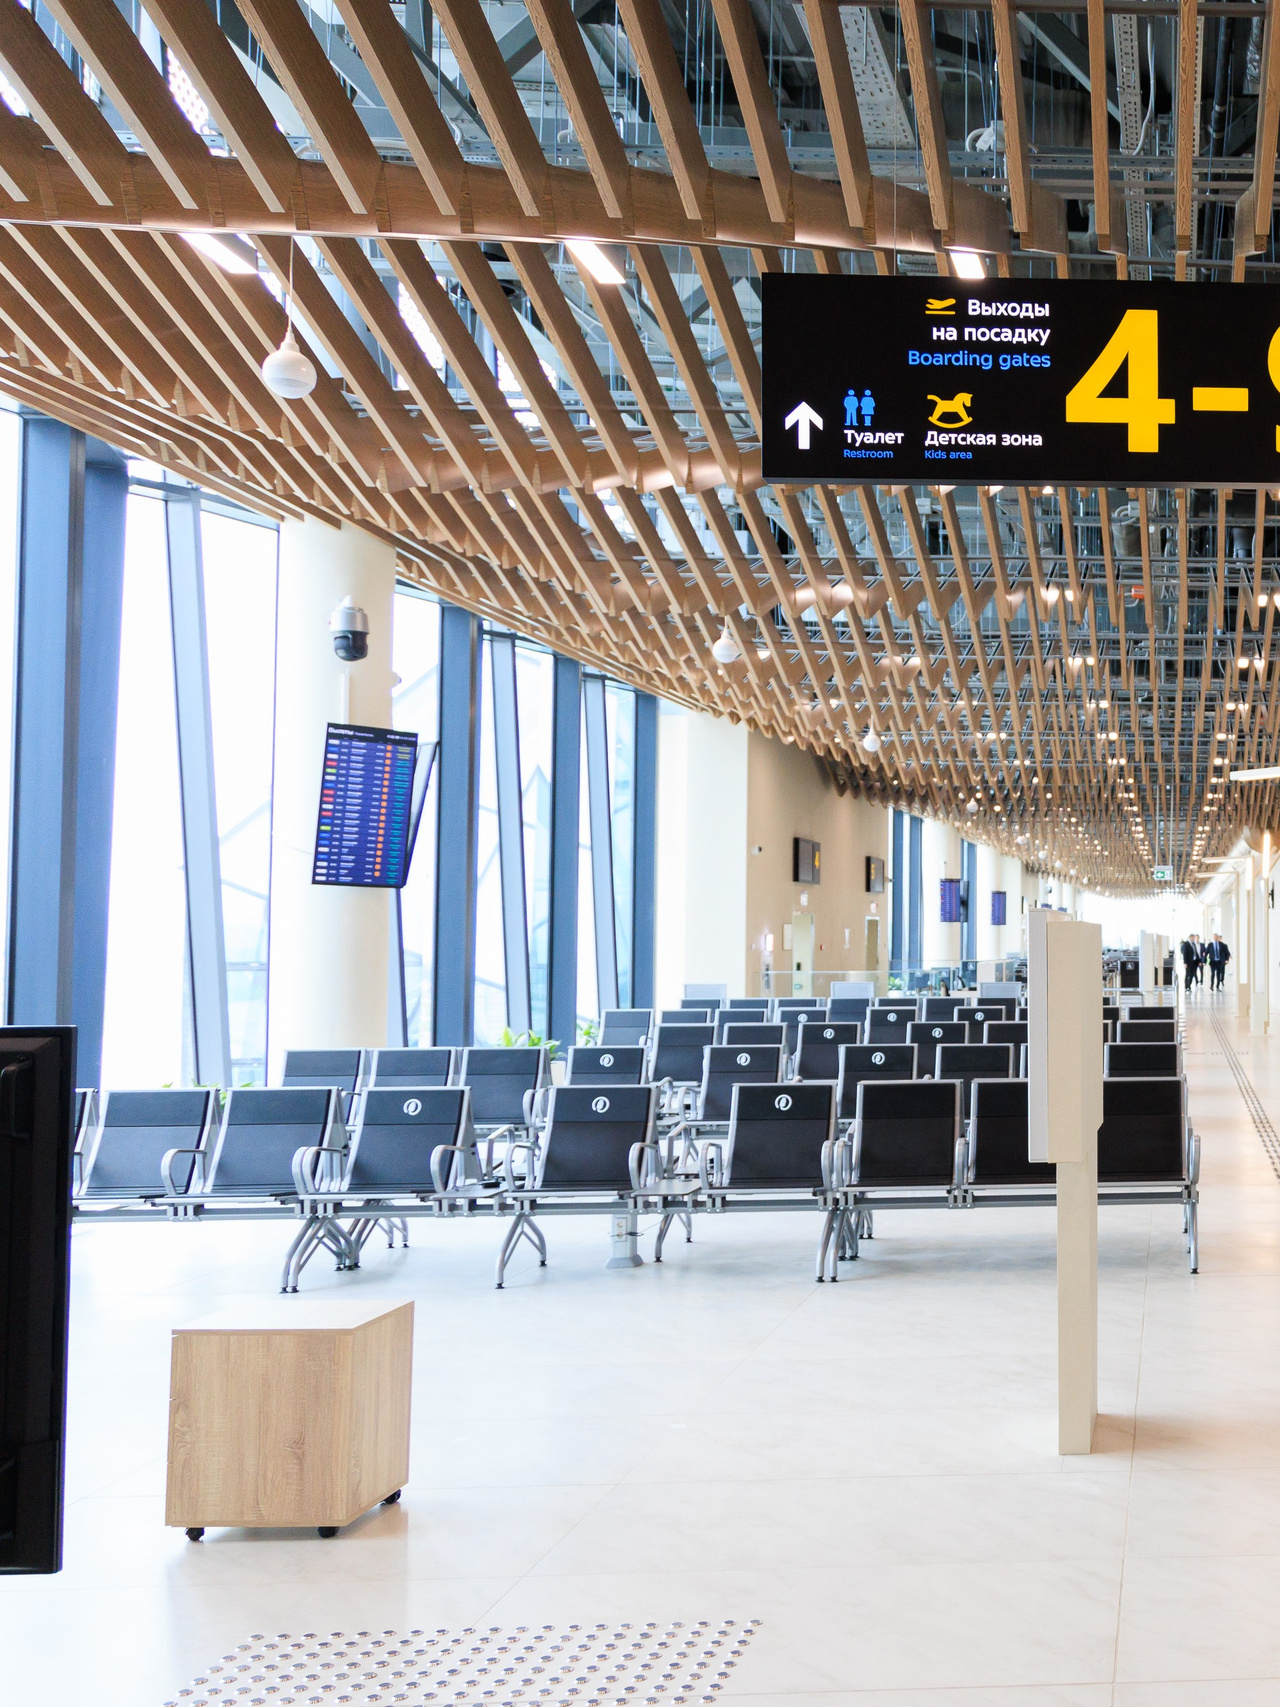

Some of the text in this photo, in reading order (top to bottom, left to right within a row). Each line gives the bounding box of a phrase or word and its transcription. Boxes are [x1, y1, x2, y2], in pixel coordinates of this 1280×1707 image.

[968, 299, 1050, 319] Выходы
[932, 327, 1051, 346] на посадку
[908, 350, 1051, 370] Boarding gates
[844, 430, 904, 447] Туалет
[925, 431, 1043, 447] Детская зона
[844, 449, 894, 459] Restroom
[925, 450, 973, 460] Kids area
